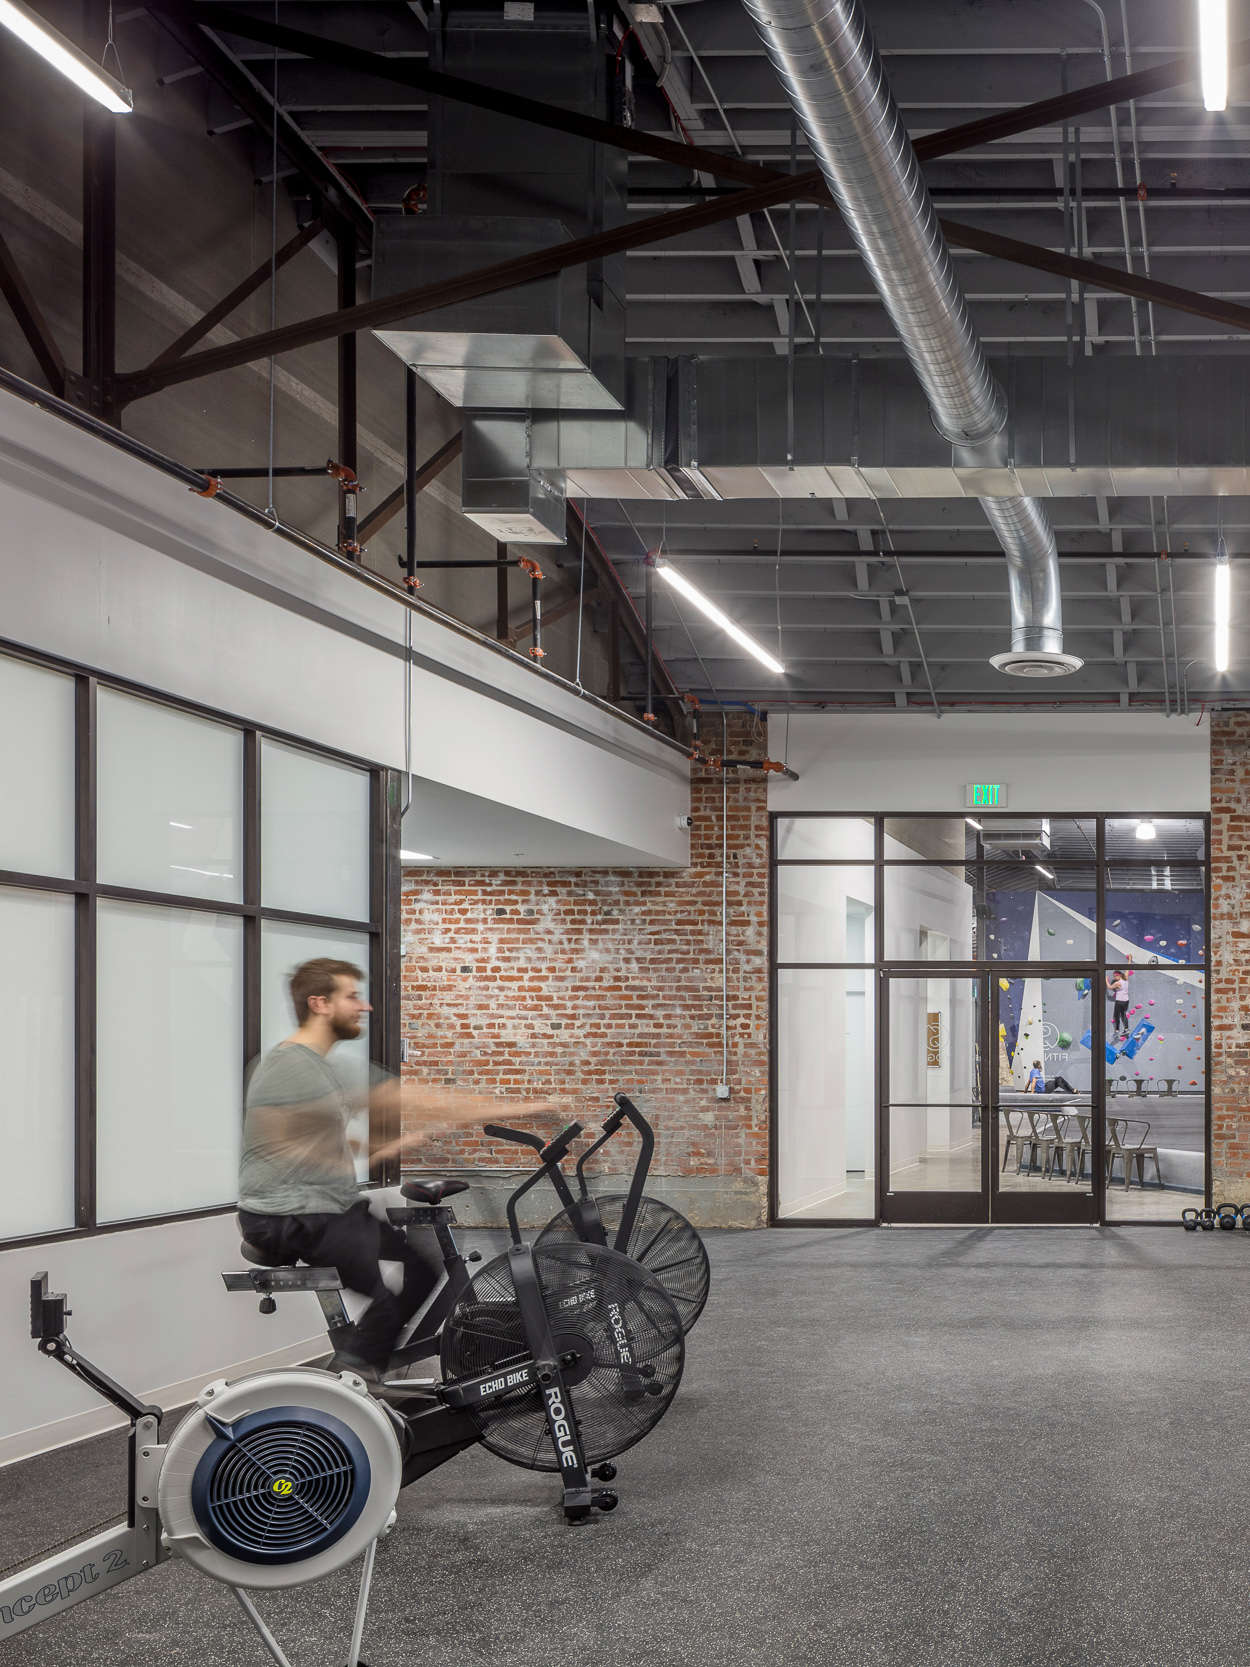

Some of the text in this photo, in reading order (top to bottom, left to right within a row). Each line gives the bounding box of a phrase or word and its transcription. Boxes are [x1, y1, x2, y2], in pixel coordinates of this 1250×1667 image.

[973, 784, 1000, 804] EXIT
[607, 1303, 632, 1365] ROGUE
[479, 1368, 529, 1397] ECHO BIKE
[545, 1386, 577, 1468] ROGUE
[102, 1548, 128, 1574] 2
